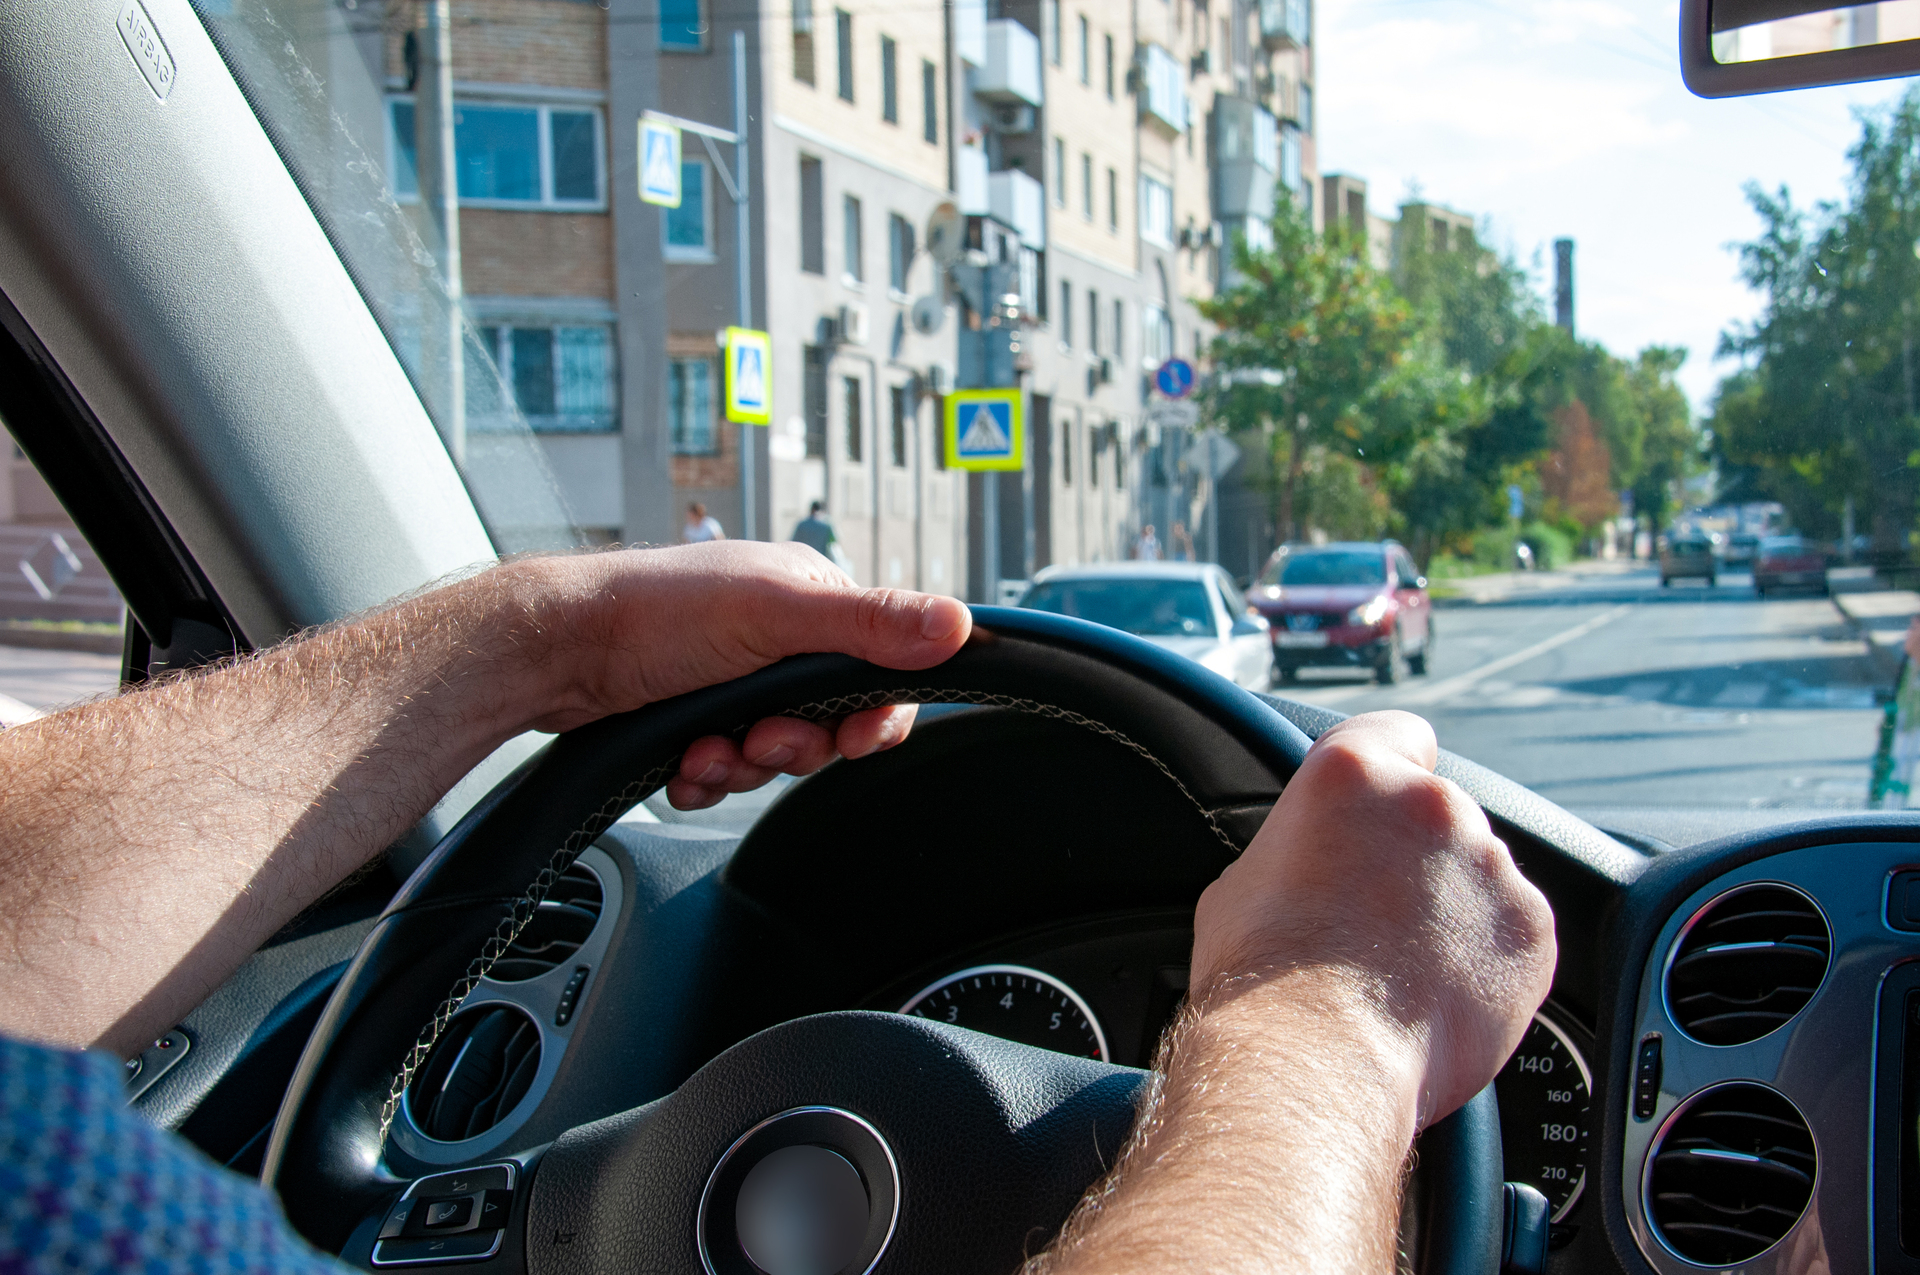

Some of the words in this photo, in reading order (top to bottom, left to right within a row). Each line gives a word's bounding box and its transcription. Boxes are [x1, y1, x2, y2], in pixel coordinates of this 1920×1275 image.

[126, 9, 169, 83] AIRBAG
[999, 991, 1014, 1010] 4
[946, 1005, 959, 1023] 3
[1049, 1012, 1063, 1030] 5
[1517, 1055, 1554, 1074] 140
[1546, 1090, 1572, 1103] 160
[1540, 1123, 1578, 1142] 180
[1541, 1166, 1567, 1180] 210
